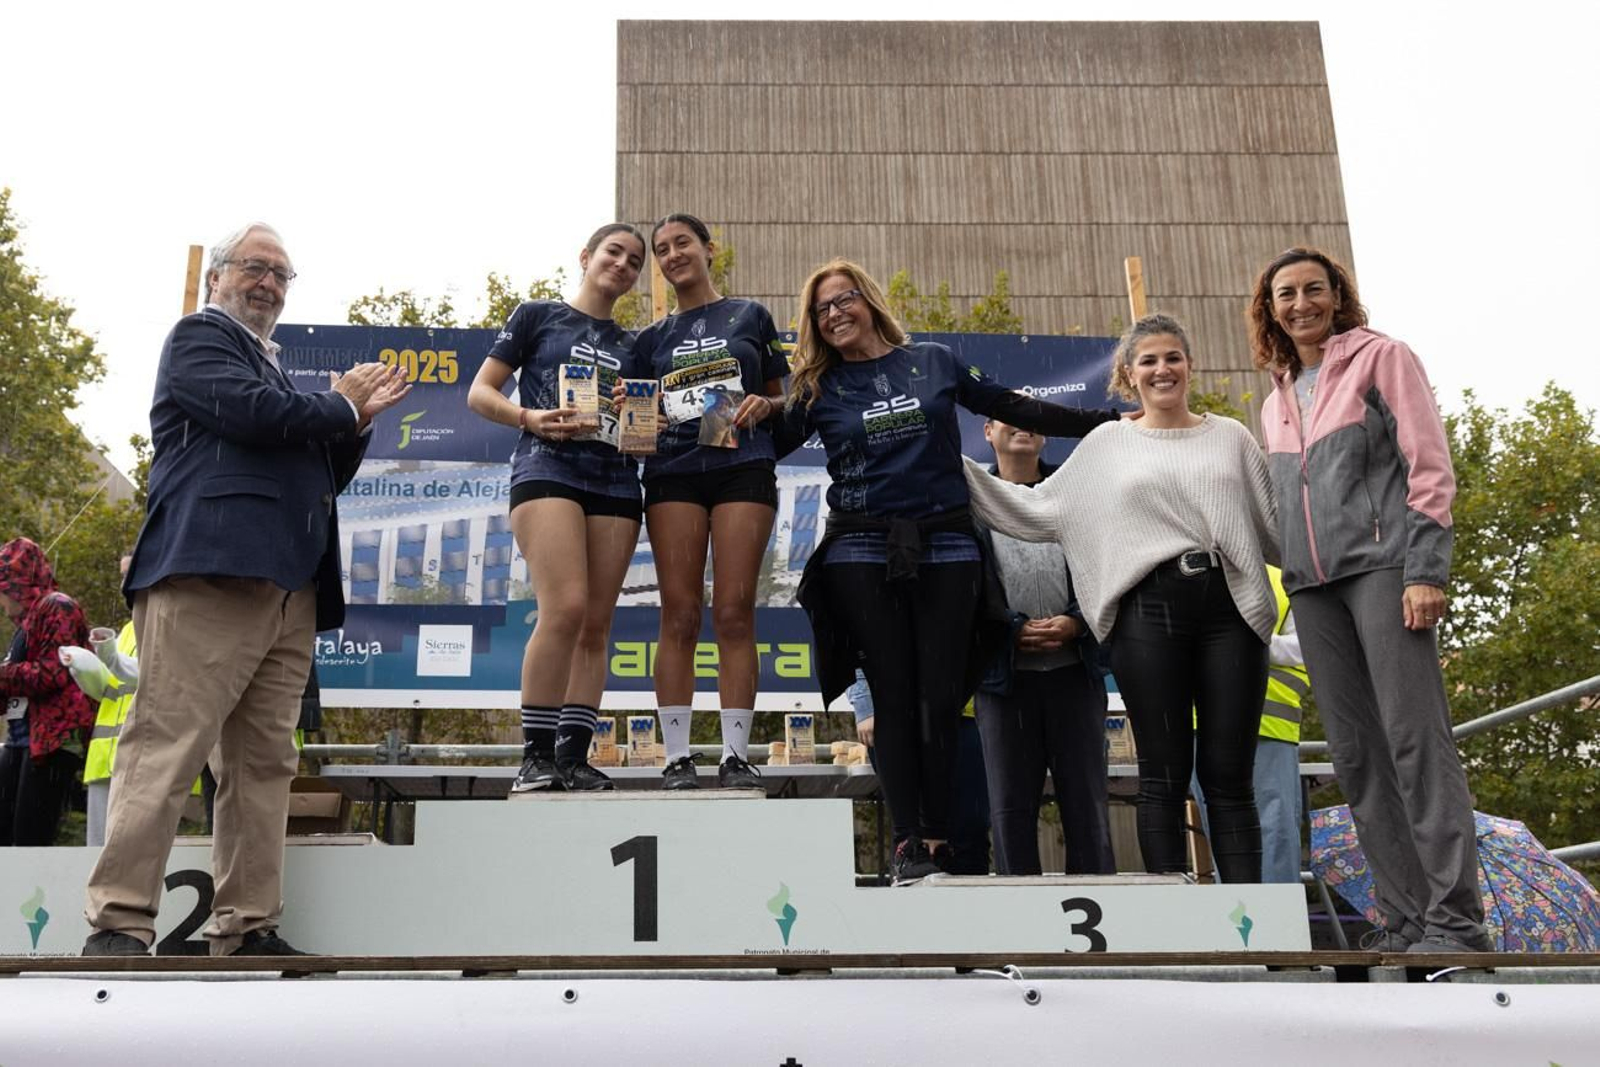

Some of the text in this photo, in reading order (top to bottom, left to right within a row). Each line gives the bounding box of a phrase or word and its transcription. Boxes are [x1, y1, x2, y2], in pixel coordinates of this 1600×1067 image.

[673, 336, 727, 356] 25
[379, 348, 459, 384] 2025
[570, 342, 621, 371] 25
[295, 368, 316, 377] partir
[564, 365, 595, 380] XXV
[625, 382, 657, 397] XXV
[1022, 382, 1086, 398] Organiza
[862, 394, 921, 420] 25
[627, 411, 634, 426] 1
[865, 415, 927, 434] POPULAR
[422, 479, 450, 498] de
[425, 639, 466, 650] Sierras
[609, 835, 658, 942] 1
[156, 869, 215, 956] 2
[1060, 897, 1108, 953] 3
